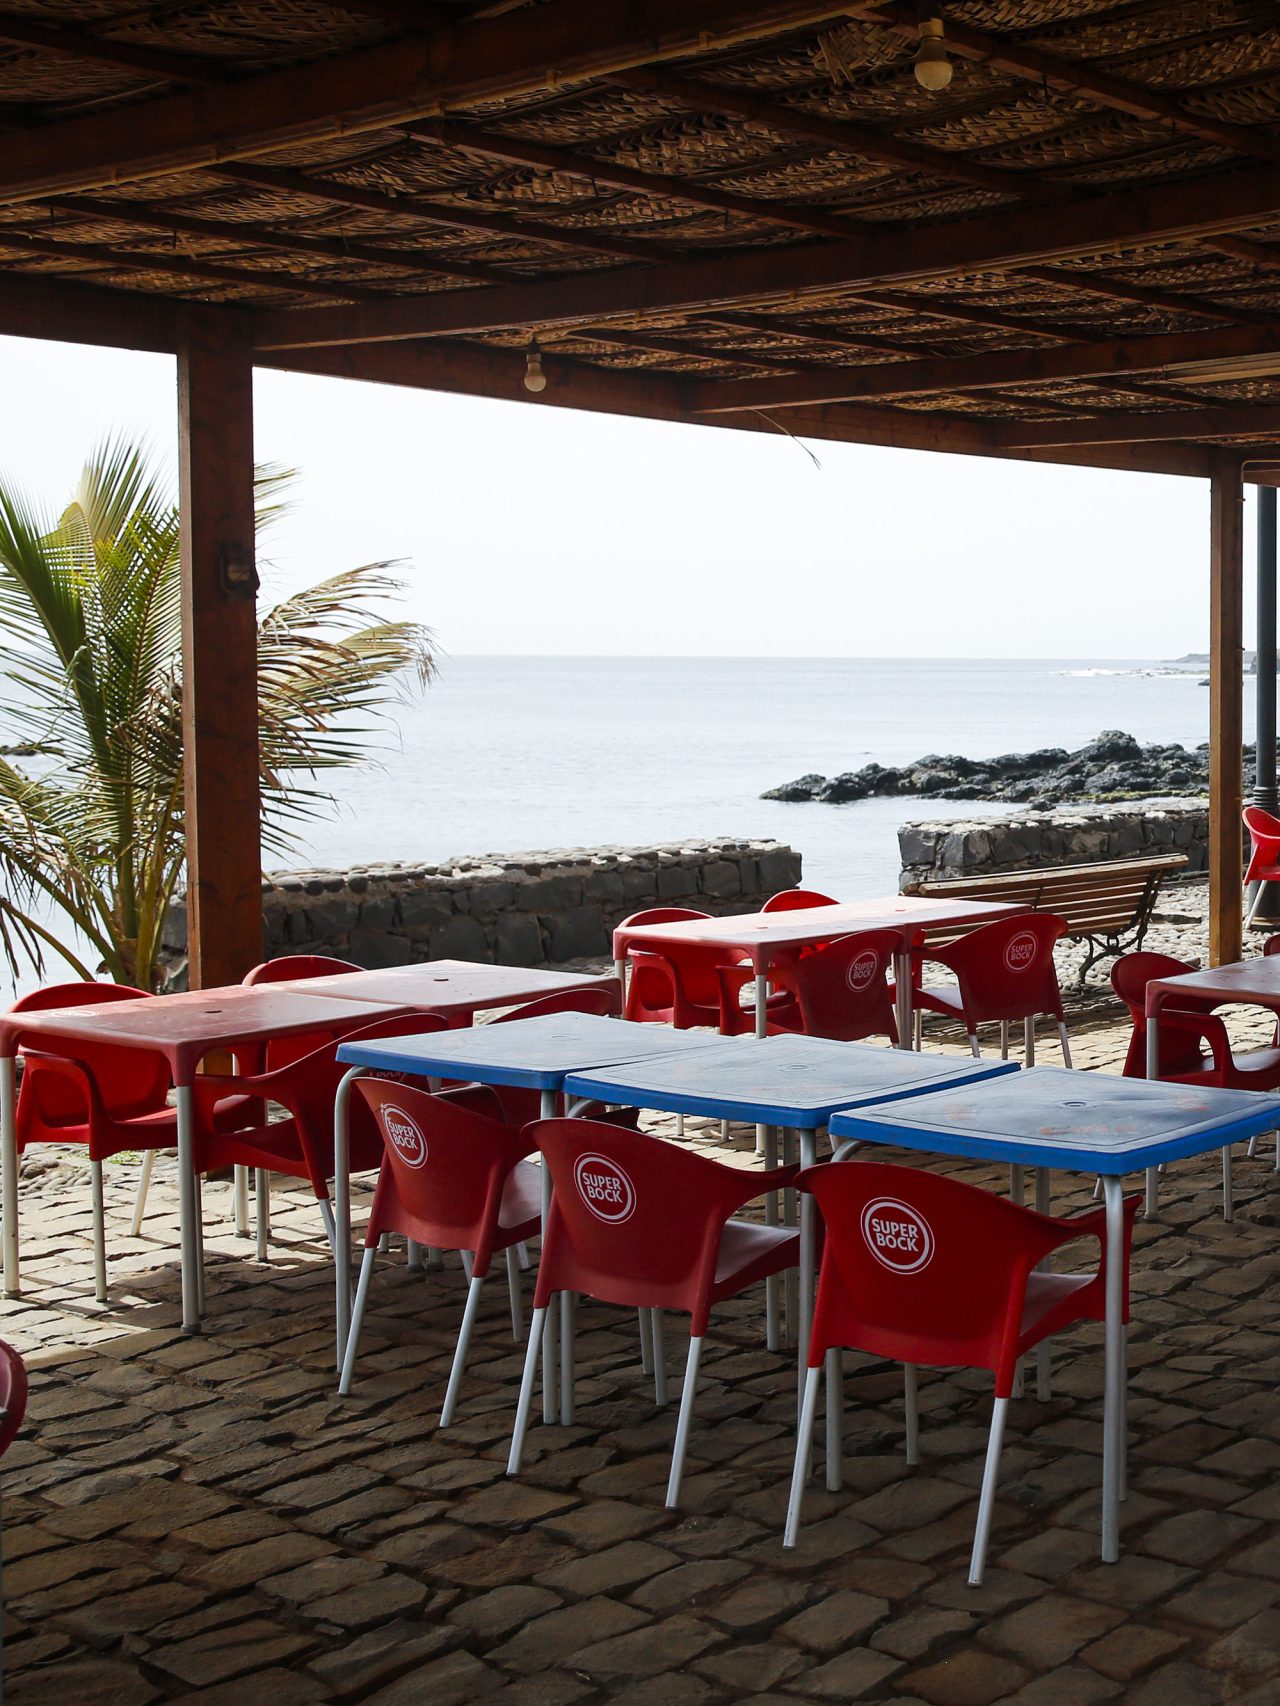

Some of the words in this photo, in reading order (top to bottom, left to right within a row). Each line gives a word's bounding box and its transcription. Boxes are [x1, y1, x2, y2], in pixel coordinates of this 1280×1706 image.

[1010, 951, 1031, 960] BOCK
[1011, 943, 1033, 953] SUPER
[853, 970, 872, 979] BOCK
[854, 961, 875, 971] SUPER
[389, 1121, 416, 1138] SUPER
[393, 1133, 418, 1150] BOCK
[582, 1172, 622, 1190] SUPER
[587, 1186, 623, 1203] BOCK
[871, 1218, 919, 1239] SUPER
[875, 1233, 919, 1252] BOCK
